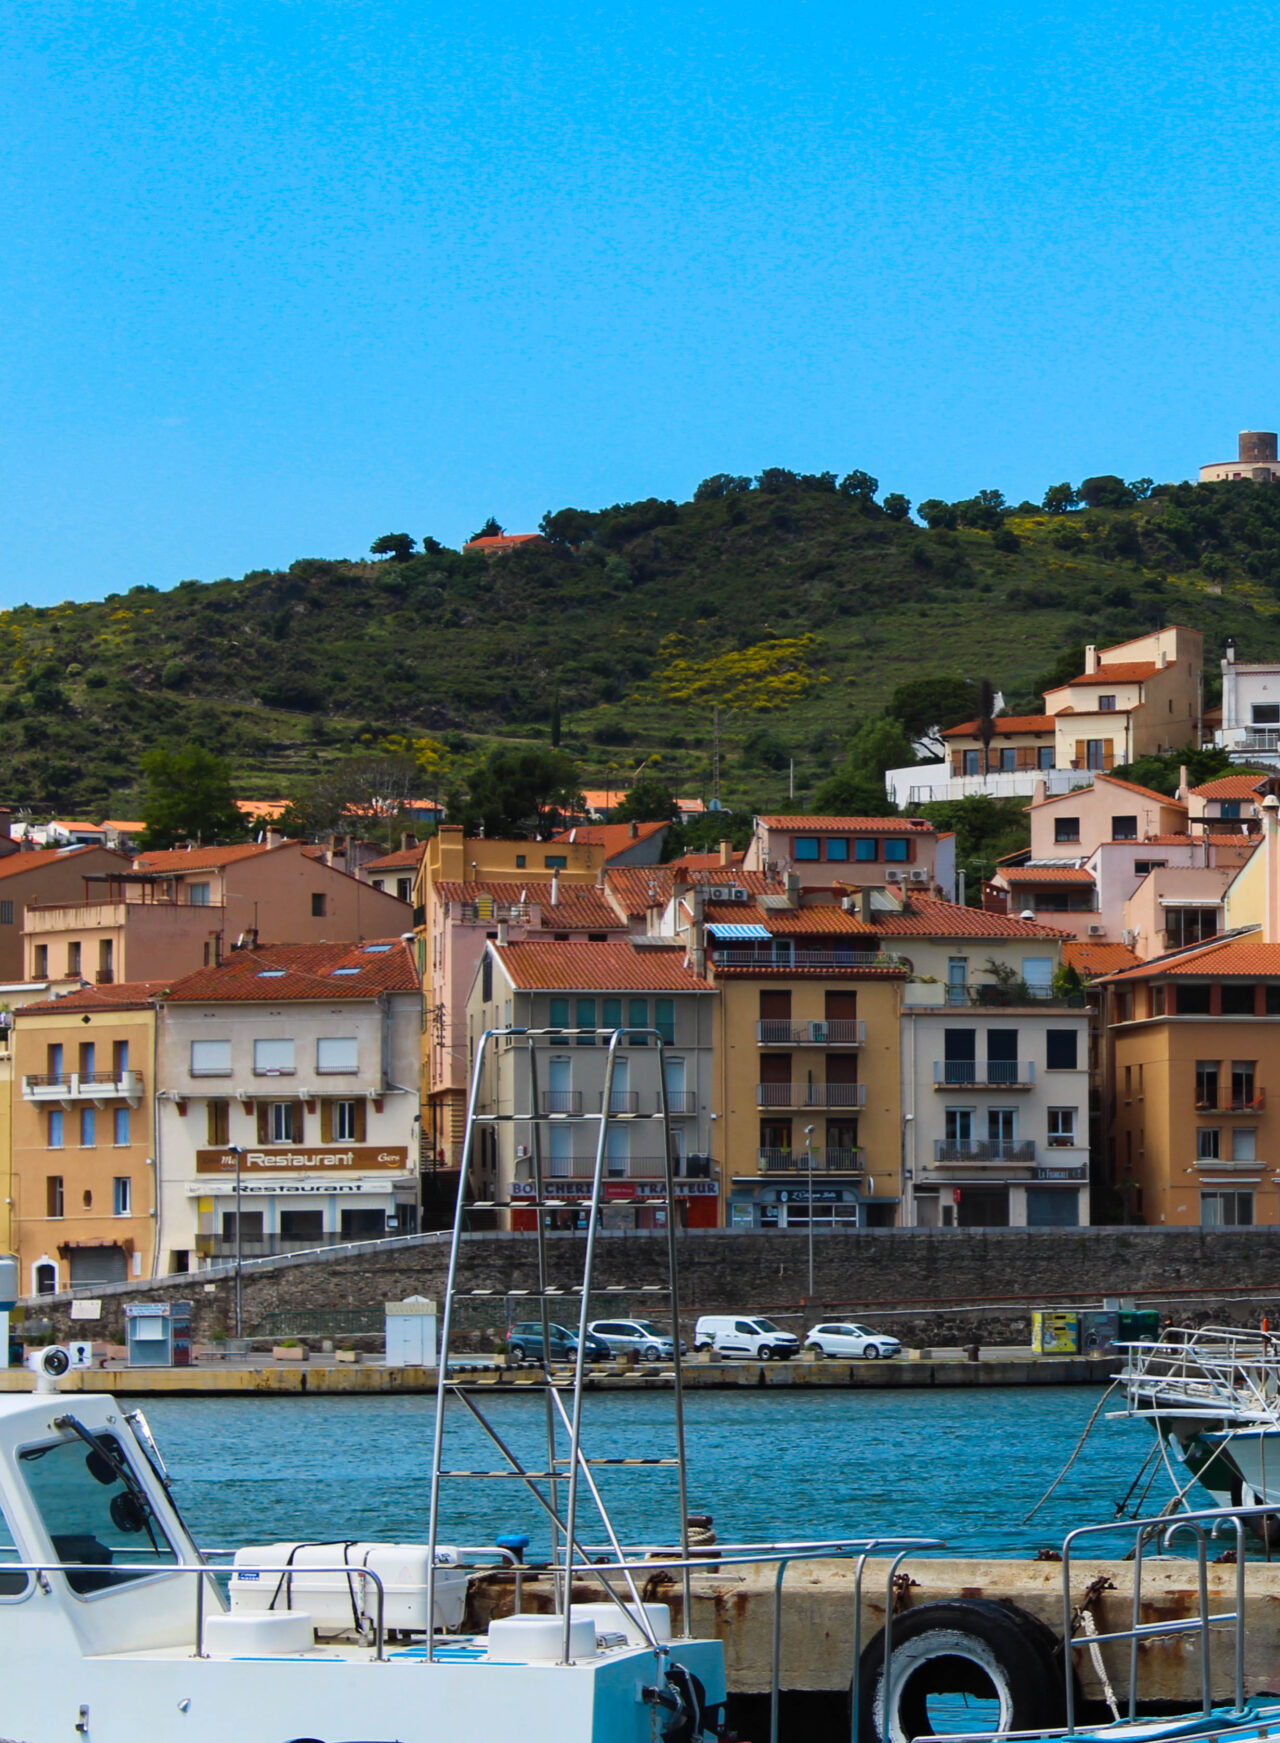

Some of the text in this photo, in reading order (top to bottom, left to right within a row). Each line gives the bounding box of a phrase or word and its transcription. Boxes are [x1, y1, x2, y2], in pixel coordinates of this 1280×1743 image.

[246, 1151, 354, 1167] Restaurant
[232, 1184, 363, 1193] Restaurant
[513, 1183, 593, 1195] BOCHERI
[638, 1183, 717, 1194] TRATEUR
